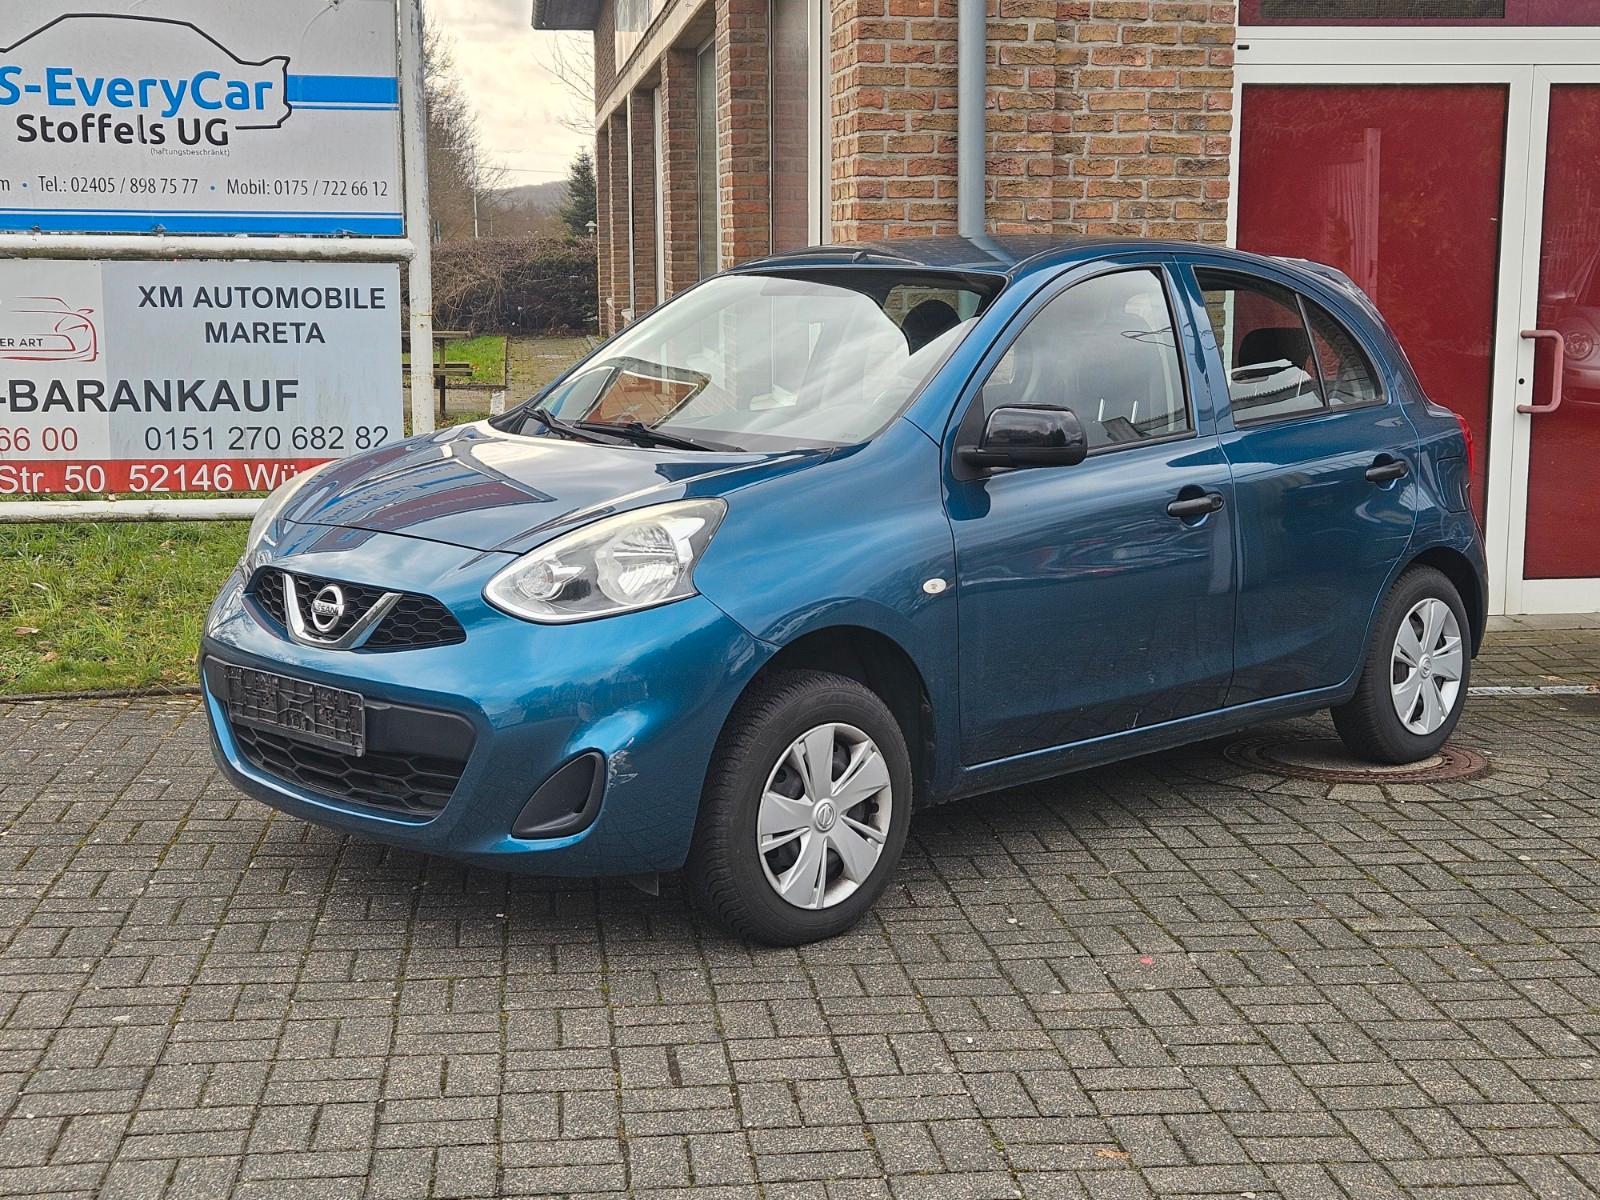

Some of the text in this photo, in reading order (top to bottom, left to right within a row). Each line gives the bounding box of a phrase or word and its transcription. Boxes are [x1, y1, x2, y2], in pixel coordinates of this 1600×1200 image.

[0, 66, 273, 118] S-EveryCar
[16, 113, 229, 146] Stoffels UG
[38, 176, 67, 192] Tel.:
[70, 177, 115, 193] 02405
[130, 178, 156, 194] 898
[160, 179, 177, 194] 75
[182, 179, 198, 194] 77
[227, 179, 270, 195] Mobil:
[274, 180, 308, 196] 0175
[323, 181, 347, 196] 722
[351, 181, 368, 196] 66
[373, 181, 388, 196] 12
[138, 286, 386, 309] XM AUTOMOBILE
[20, 338, 43, 347] ART
[205, 322, 326, 343] MARETA
[42, 427, 78, 451] 00
[145, 426, 389, 451] 0151 270 682 82
[0, 465, 51, 493] Str.
[64, 465, 106, 493] 50
[129, 465, 233, 493] 52146
